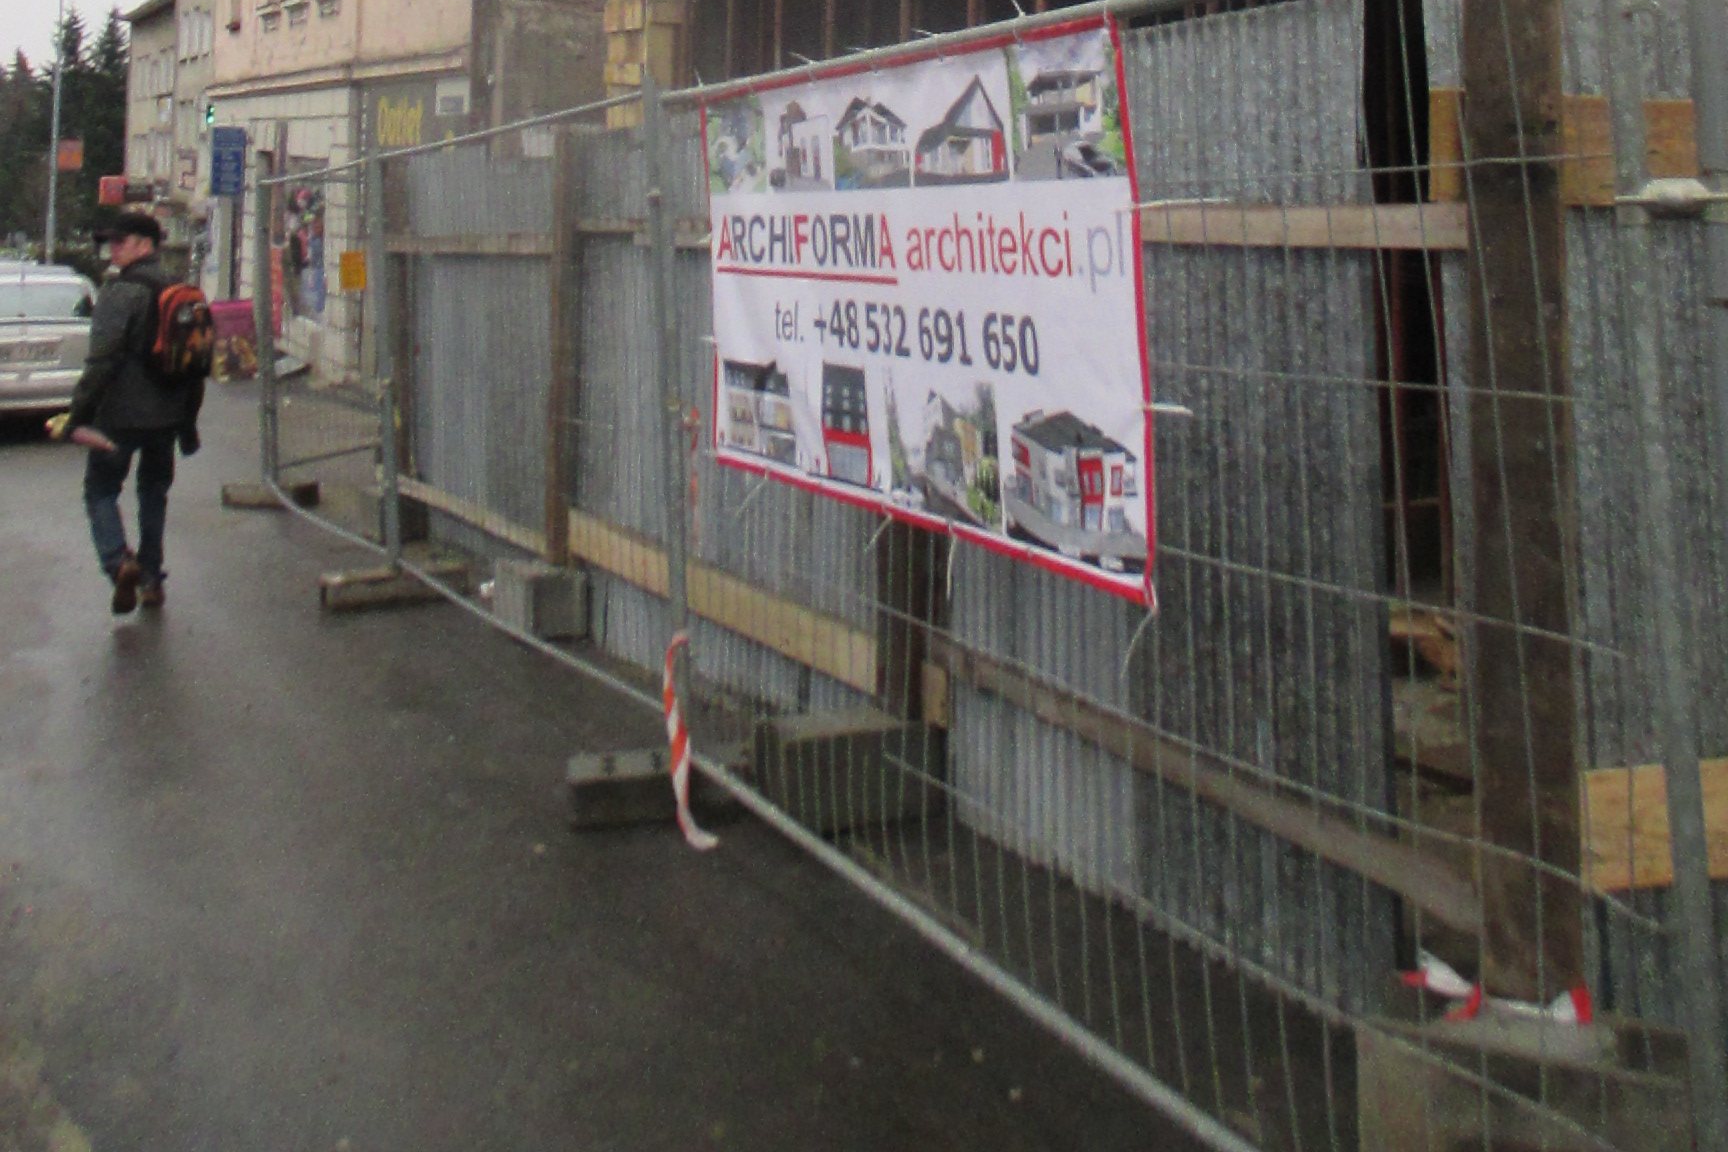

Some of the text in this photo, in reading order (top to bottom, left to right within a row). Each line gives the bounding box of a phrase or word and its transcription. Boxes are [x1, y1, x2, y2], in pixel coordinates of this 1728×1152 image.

[717, 211, 1126, 293] ARCHIFORMA architekci.pl
[775, 299, 1039, 376] tel. +48 532 691 650
